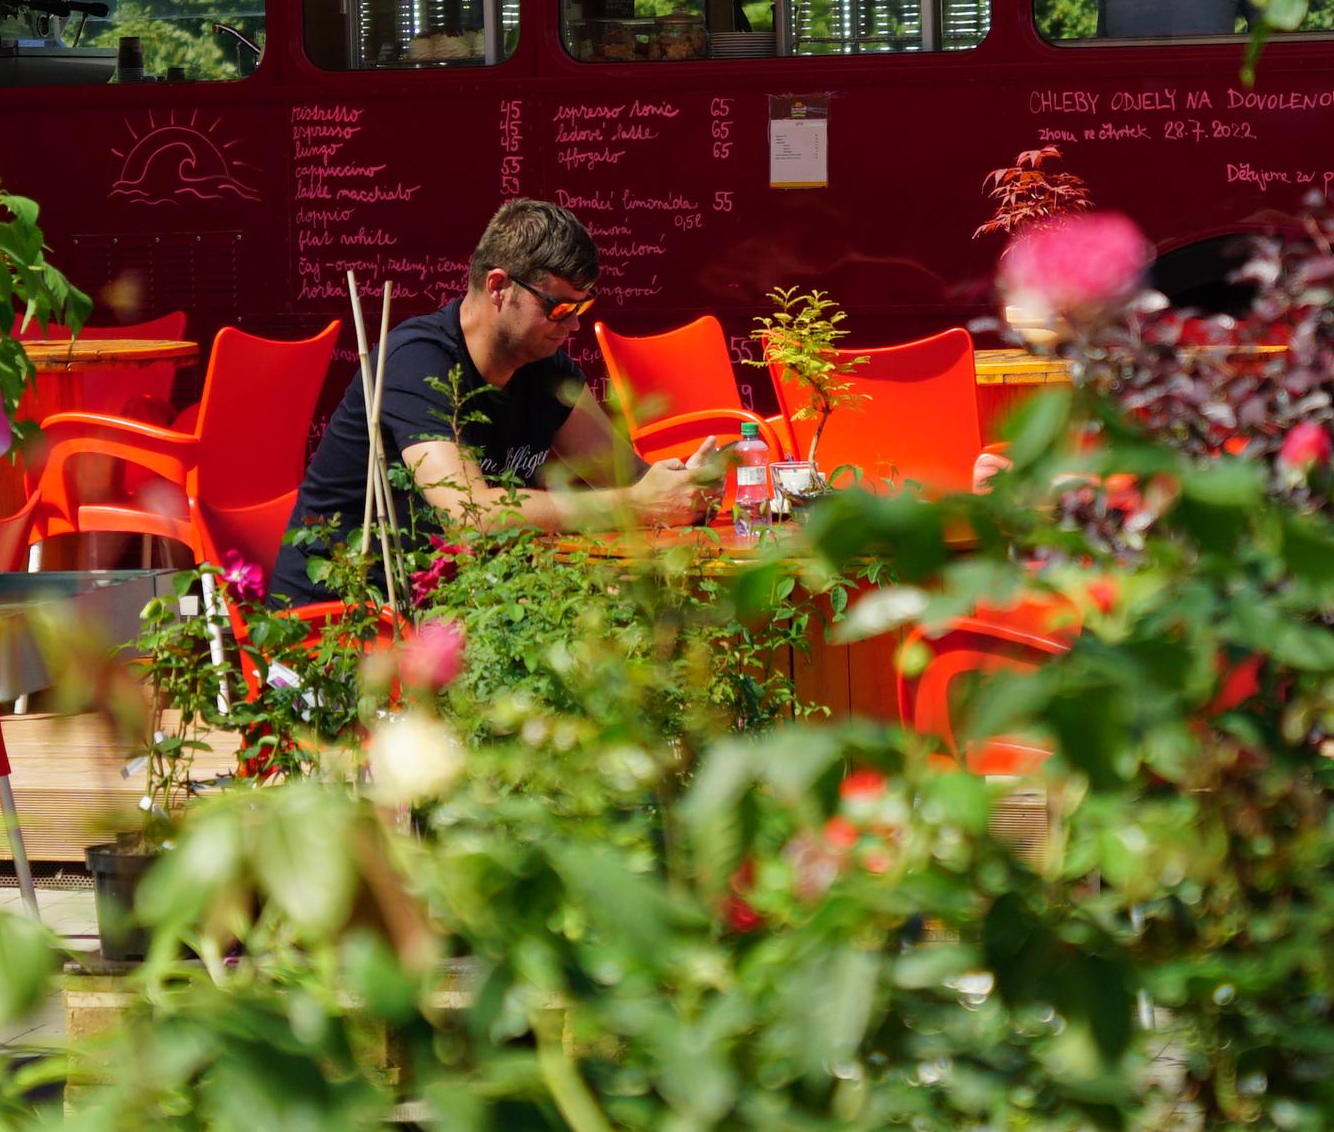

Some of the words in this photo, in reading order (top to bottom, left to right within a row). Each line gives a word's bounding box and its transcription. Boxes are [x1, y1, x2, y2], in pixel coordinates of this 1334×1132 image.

[500, 100, 523, 120] 45
[553, 104, 626, 127] espresso
[629, 99, 680, 118] tonic
[710, 97, 736, 117] 65
[1029, 90, 1100, 114] CHLEBY
[1111, 88, 1178, 112] ODJELY
[1186, 90, 1213, 110] NA
[293, 124, 361, 145] espresso
[499, 120, 523, 138] 45
[555, 121, 608, 143] ledové
[611, 123, 660, 141] latte
[711, 119, 735, 139] 65
[294, 141, 344, 166] lungo
[500, 136, 524, 153] 45
[557, 147, 626, 171] affogato
[712, 141, 735, 160] 65
[295, 162, 386, 188] cappuccino
[500, 156, 524, 175] 55
[1296, 171, 1316, 183] za
[336, 183, 421, 202] macchiato
[500, 176, 520, 196] 59
[554, 188, 615, 210] Domácí
[622, 188, 700, 210] limonáda
[711, 191, 735, 212] 55
[296, 207, 356, 229] doppio
[298, 229, 334, 252] flat
[340, 227, 398, 245] white
